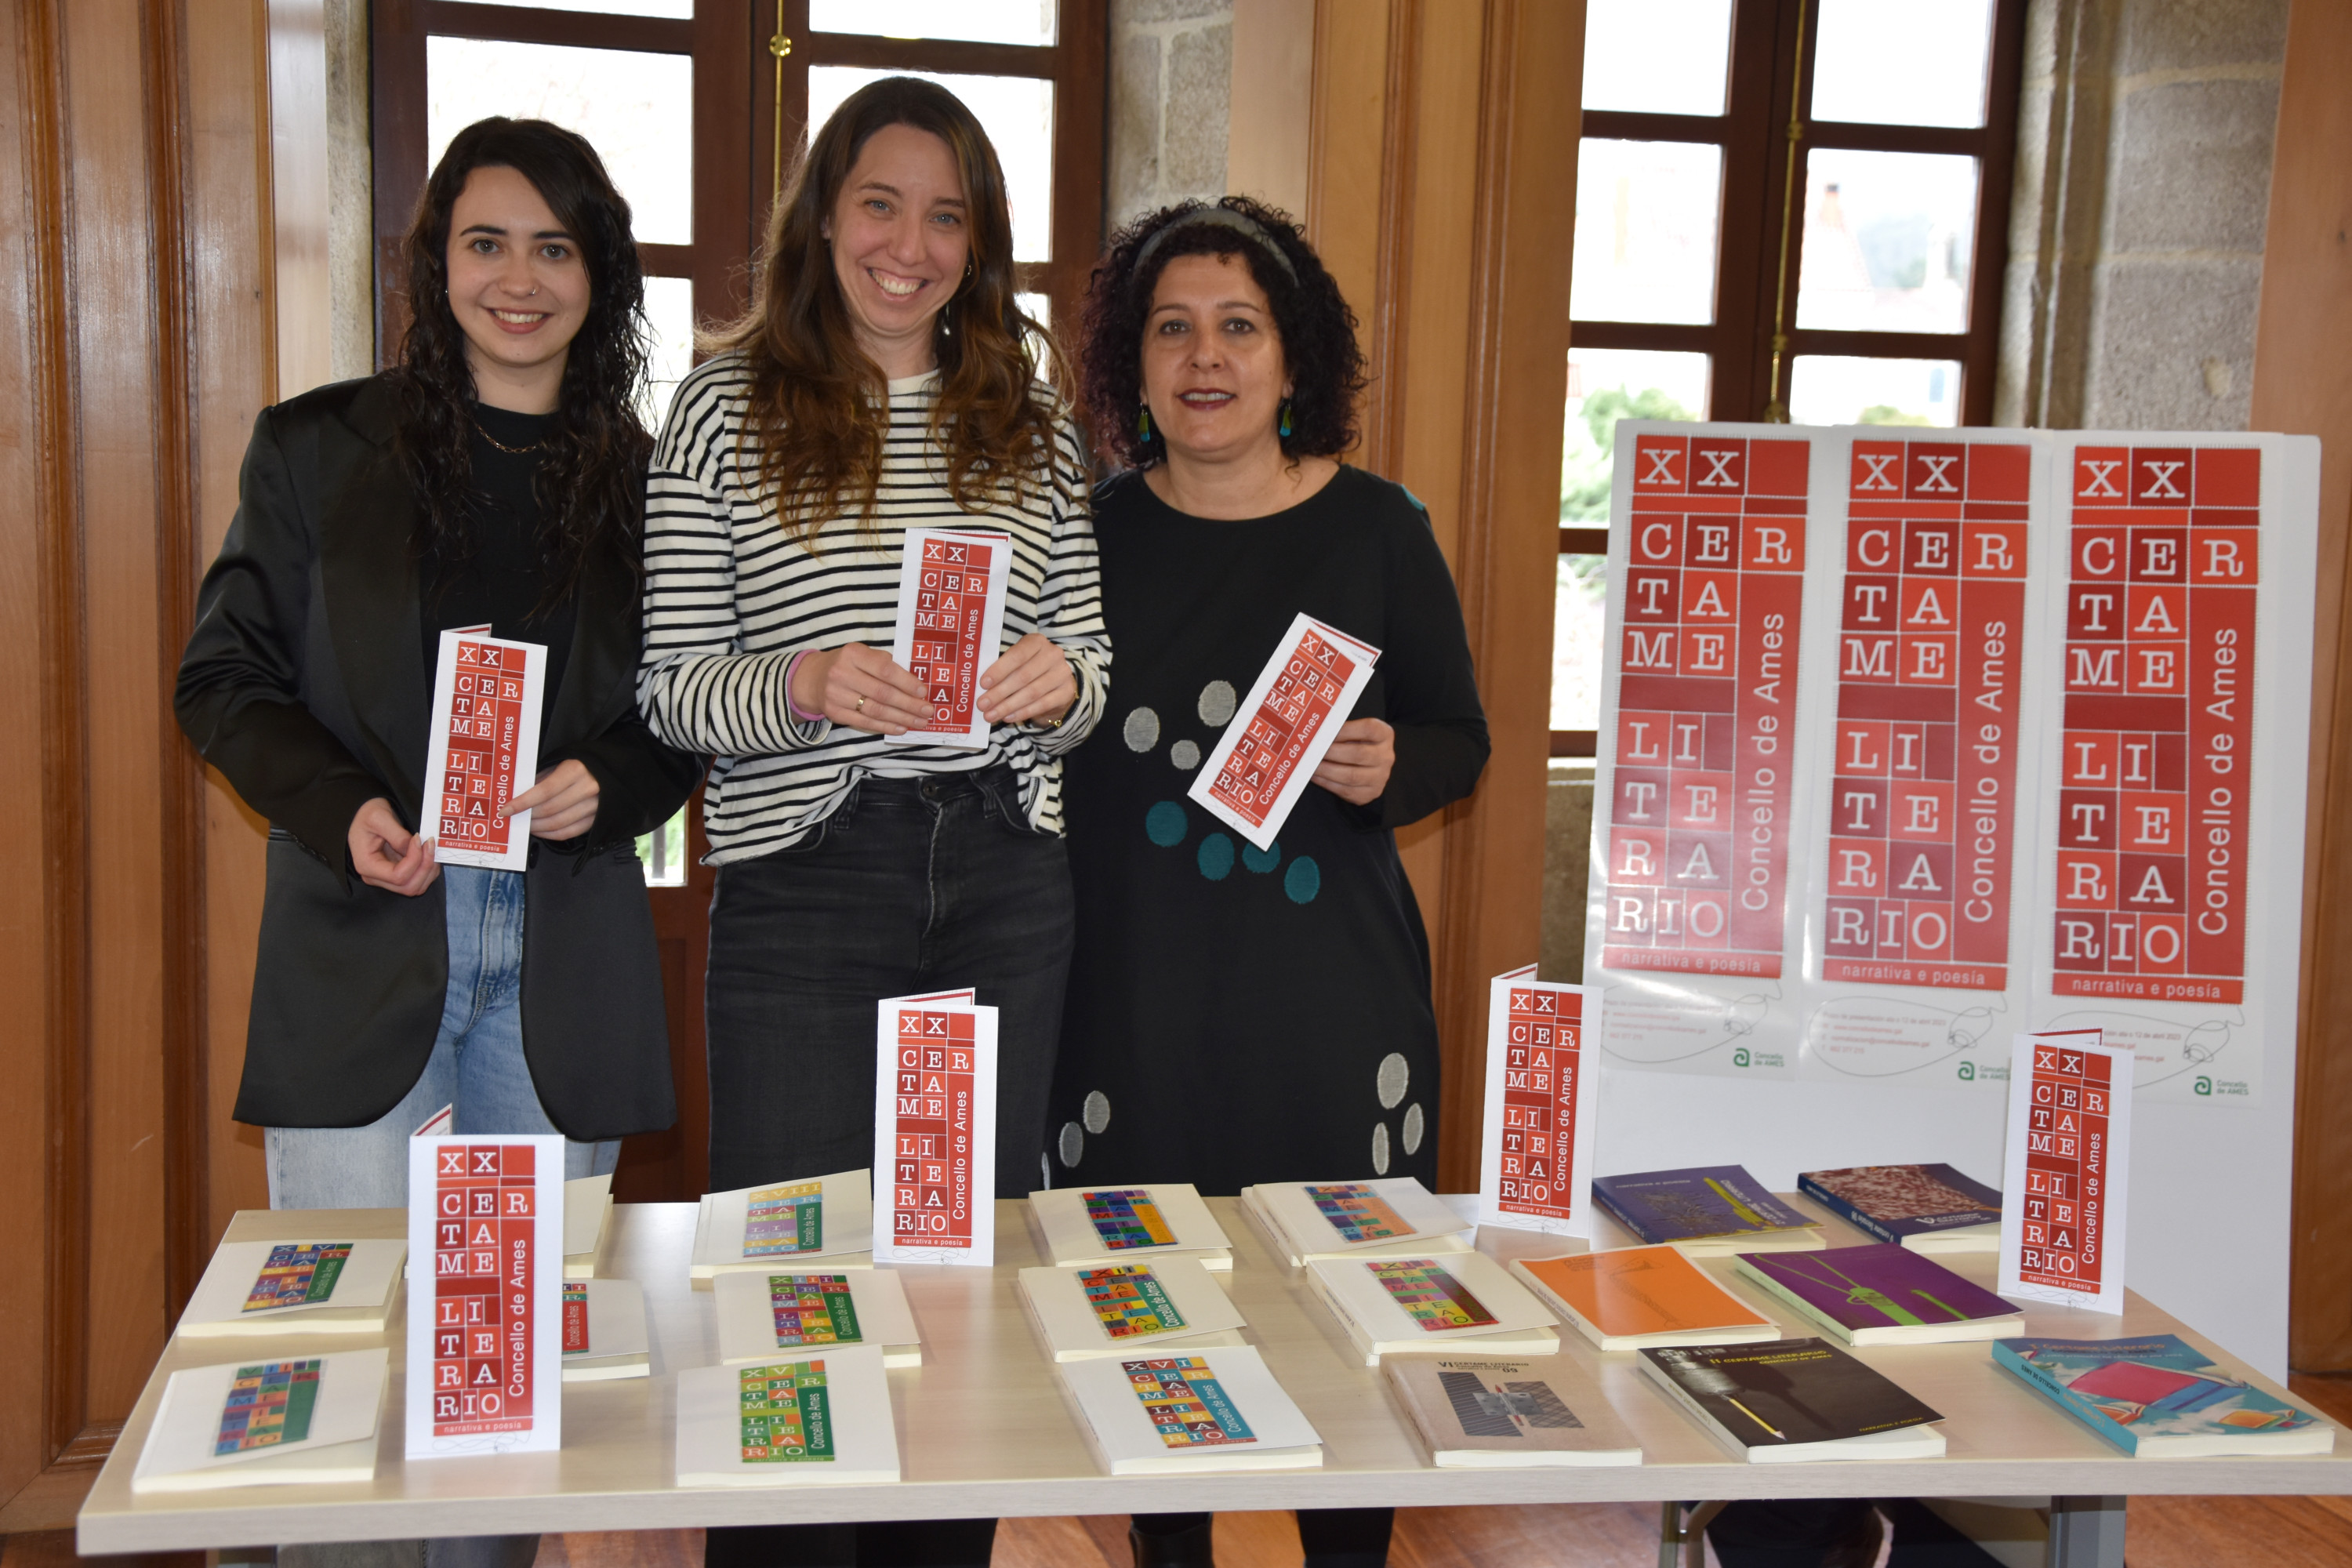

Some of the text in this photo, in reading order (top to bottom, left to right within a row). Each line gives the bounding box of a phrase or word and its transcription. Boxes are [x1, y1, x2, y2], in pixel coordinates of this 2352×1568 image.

[1639, 448, 1740, 487] XX
[1854, 454, 1958, 492] XX
[2078, 461, 2185, 498] XX
[924, 543, 965, 561] XX
[1640, 523, 1792, 564] CER
[1857, 529, 2013, 572] CER
[2082, 537, 2244, 576] CER
[924, 571, 983, 590] CER
[922, 591, 959, 608] TA
[1637, 578, 1730, 618] TA
[1854, 586, 1951, 626] TA
[2080, 593, 2179, 633] TA
[459, 646, 499, 665] XX
[956, 608, 978, 711] Concello de Ames
[1626, 630, 1725, 671] ME
[1843, 639, 1944, 680] ME
[2070, 648, 2174, 688] ME
[459, 675, 518, 697] CER
[456, 696, 494, 715] TA
[452, 717, 491, 735] ME
[500, 714, 514, 750] Ames
[1627, 722, 1698, 761] LI
[1846, 731, 1918, 771] LI
[450, 752, 479, 769] LI
[499, 753, 510, 769] de
[1258, 708, 1320, 804] Concello de Ames
[1740, 614, 1784, 912] Concello de Ames
[2073, 742, 2148, 781] LI
[1964, 622, 2005, 923] Concello de Ames
[2198, 629, 2237, 935] Concello de Ames
[448, 775, 485, 793] TE
[445, 797, 485, 815] RA
[1624, 782, 1717, 822] TE
[1844, 792, 1938, 833] TE
[441, 818, 486, 837] RIO
[2072, 804, 2170, 844] TE
[1618, 838, 1720, 880] RA
[1837, 850, 1942, 891] RA
[2067, 862, 2174, 903] RA
[1610, 895, 1724, 938] RIO
[1830, 906, 1947, 950] RIO
[2060, 920, 2180, 964] RIO
[1621, 952, 1689, 967] narrativa
[1695, 957, 1704, 967] e
[1842, 964, 1911, 980] narrativa
[1917, 970, 1926, 980] e
[2072, 978, 2143, 994] narrativa
[2151, 984, 2160, 994] e
[1512, 994, 1553, 1013] XX
[901, 1016, 945, 1033] XX
[1513, 1026, 1575, 1047] CER
[903, 1049, 969, 1068] CER
[1512, 1050, 1549, 1069] TA
[2036, 1051, 2081, 1073] XX
[902, 1073, 943, 1091] TA
[1507, 1072, 1547, 1091] ME
[898, 1097, 942, 1115] ME
[2037, 1083, 2104, 1110] CER
[1508, 1110, 1537, 1128] LI
[1553, 1067, 1571, 1192] Concello de Ames
[2035, 1108, 2077, 1130] TA
[901, 1137, 931, 1154] LI
[1507, 1135, 1544, 1154] TE
[2031, 1131, 2074, 1153] ME
[440, 1152, 497, 1172] XX
[953, 1090, 967, 1219] Concello de Ames
[901, 1163, 941, 1181] TE
[1504, 1158, 1545, 1178] RA
[1501, 1181, 1547, 1202] RIO
[2031, 1171, 2063, 1192] LI
[443, 1192, 528, 1214] CER
[898, 1189, 943, 1206] RA
[2082, 1130, 2100, 1264] Concello de Ames
[2030, 1198, 2071, 1221] TE
[443, 1222, 495, 1243] TA
[896, 1213, 946, 1232] RIO
[2027, 1223, 2072, 1247] RA
[437, 1251, 493, 1273] ME
[2023, 1248, 2074, 1273] RIO
[2028, 1275, 2059, 1285] narrativa
[441, 1301, 481, 1323] LI
[509, 1239, 525, 1397] Concello de Ames
[441, 1332, 493, 1356] TE
[439, 1363, 496, 1386] RA
[436, 1393, 500, 1417] RIO
[444, 1425, 481, 1433] narrativa
